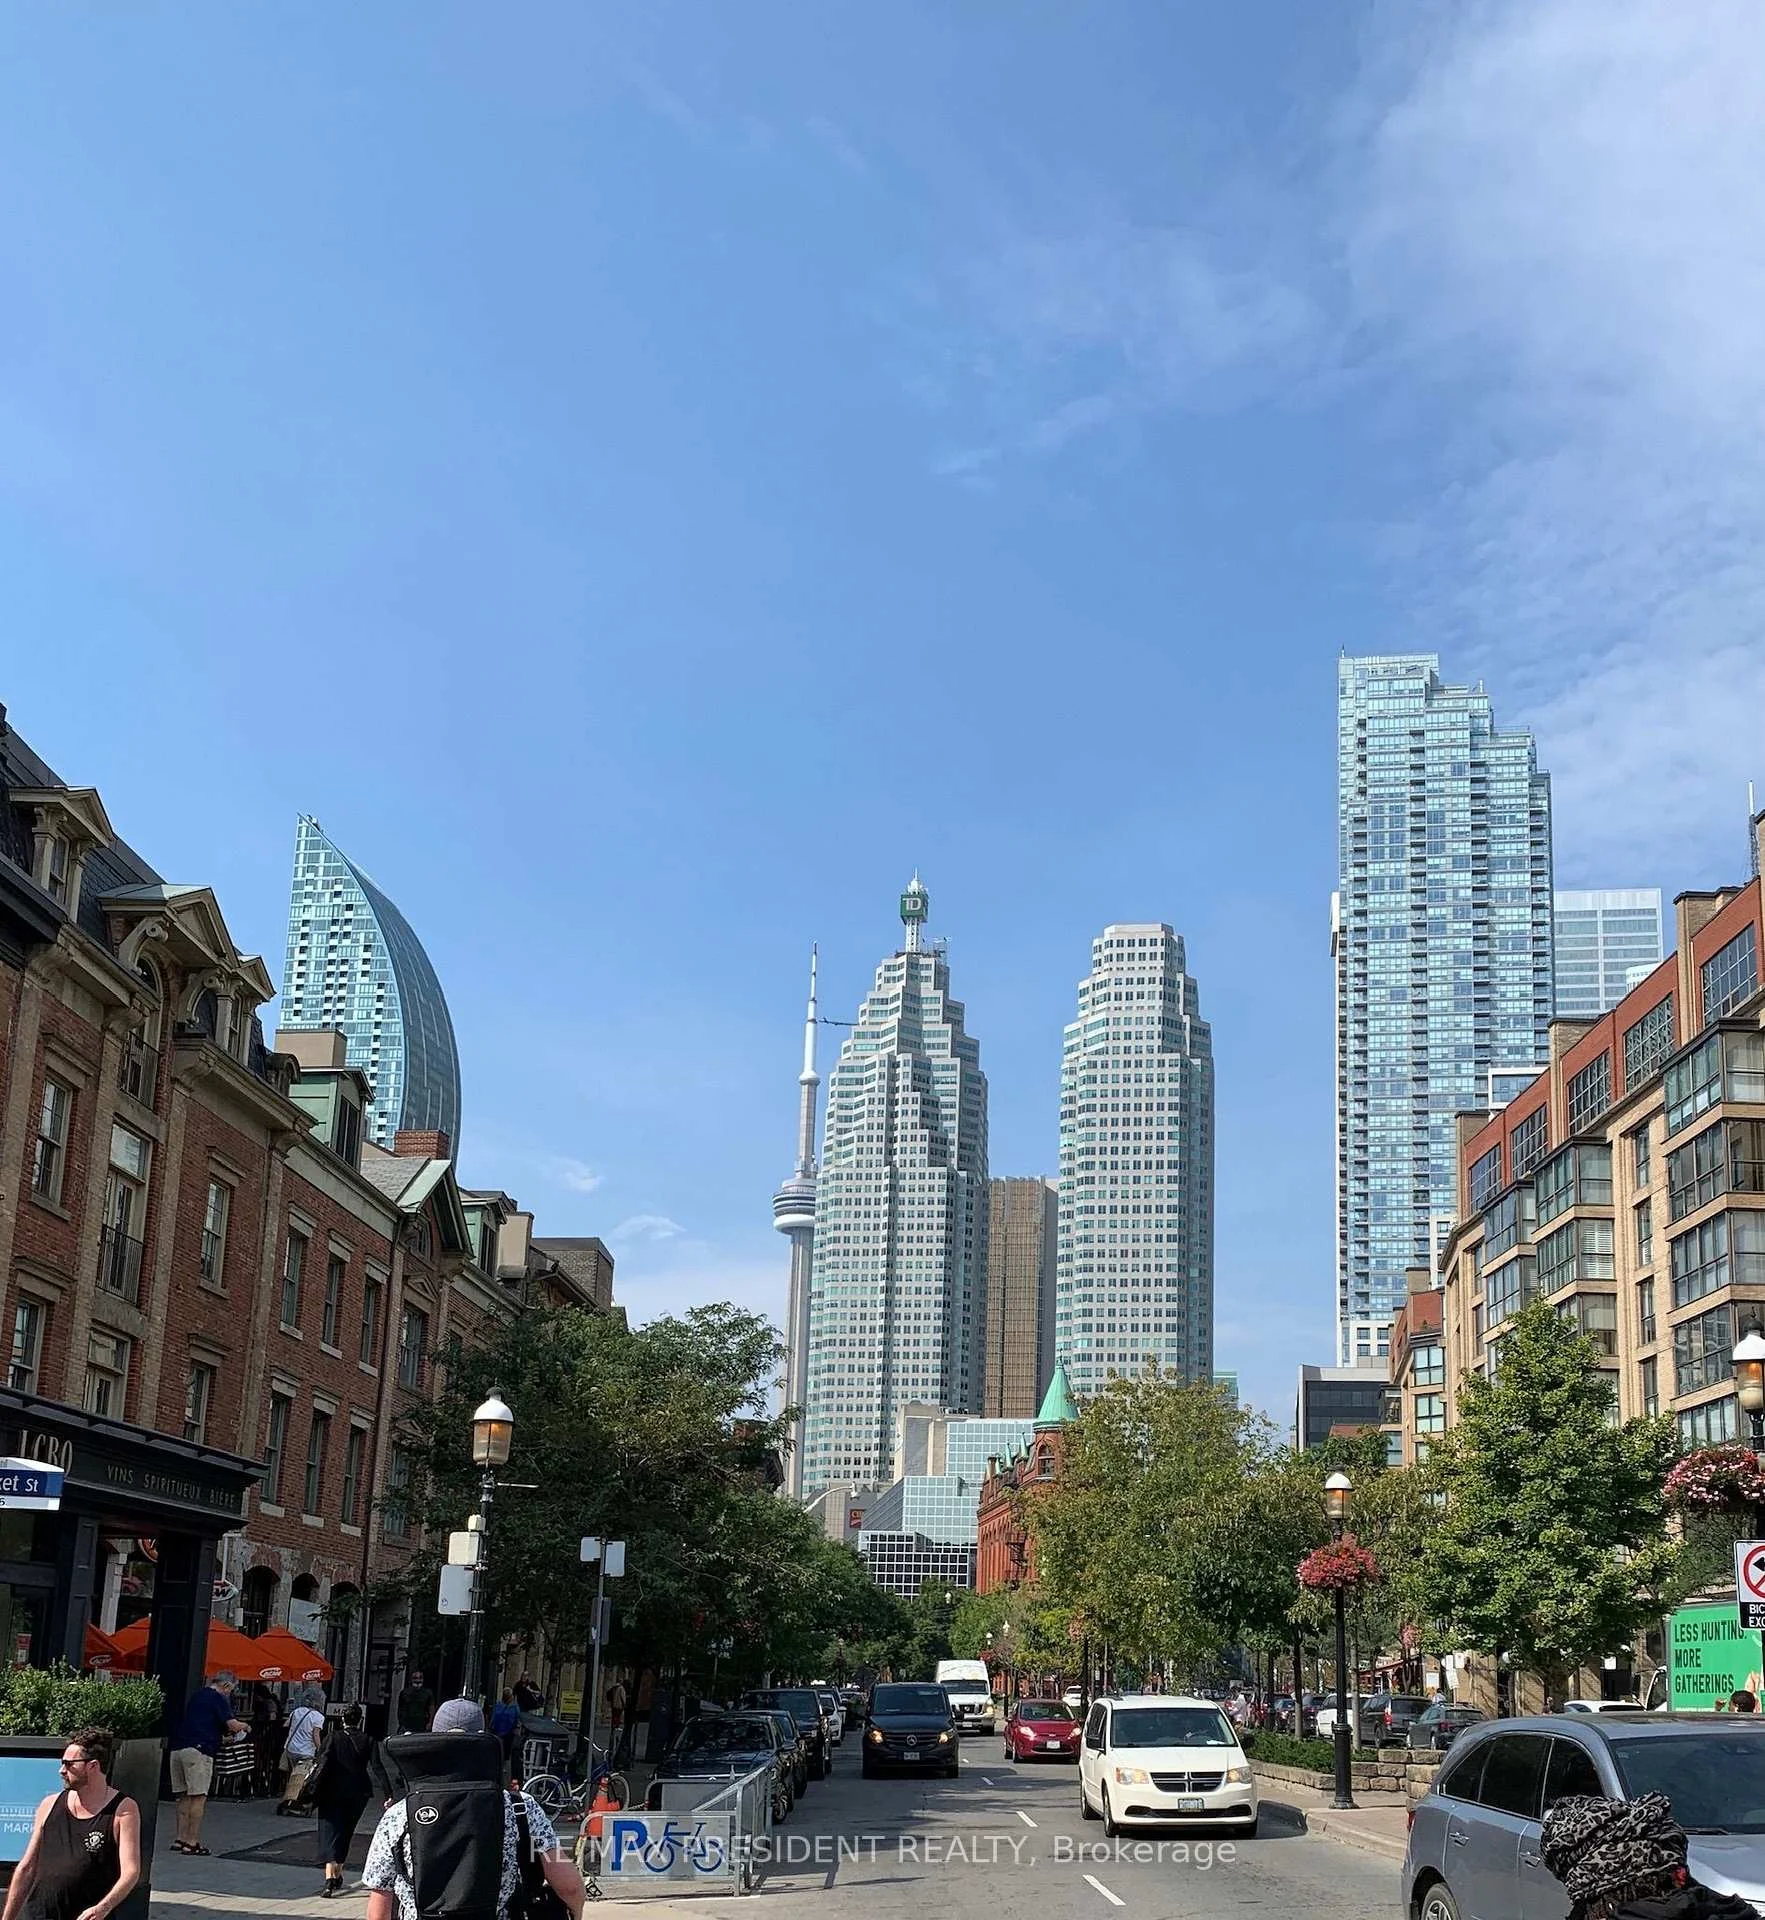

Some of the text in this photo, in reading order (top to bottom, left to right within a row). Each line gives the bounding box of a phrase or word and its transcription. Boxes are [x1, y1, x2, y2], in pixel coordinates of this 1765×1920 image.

[902, 897, 921, 910] TD
[107, 1464, 134, 1484] VINS
[25, 1478, 39, 1492] St
[1674, 1623, 1699, 1643] LESS
[1674, 1647, 1702, 1668] MORE
[1675, 1673, 1735, 1694] GATHERINGS
